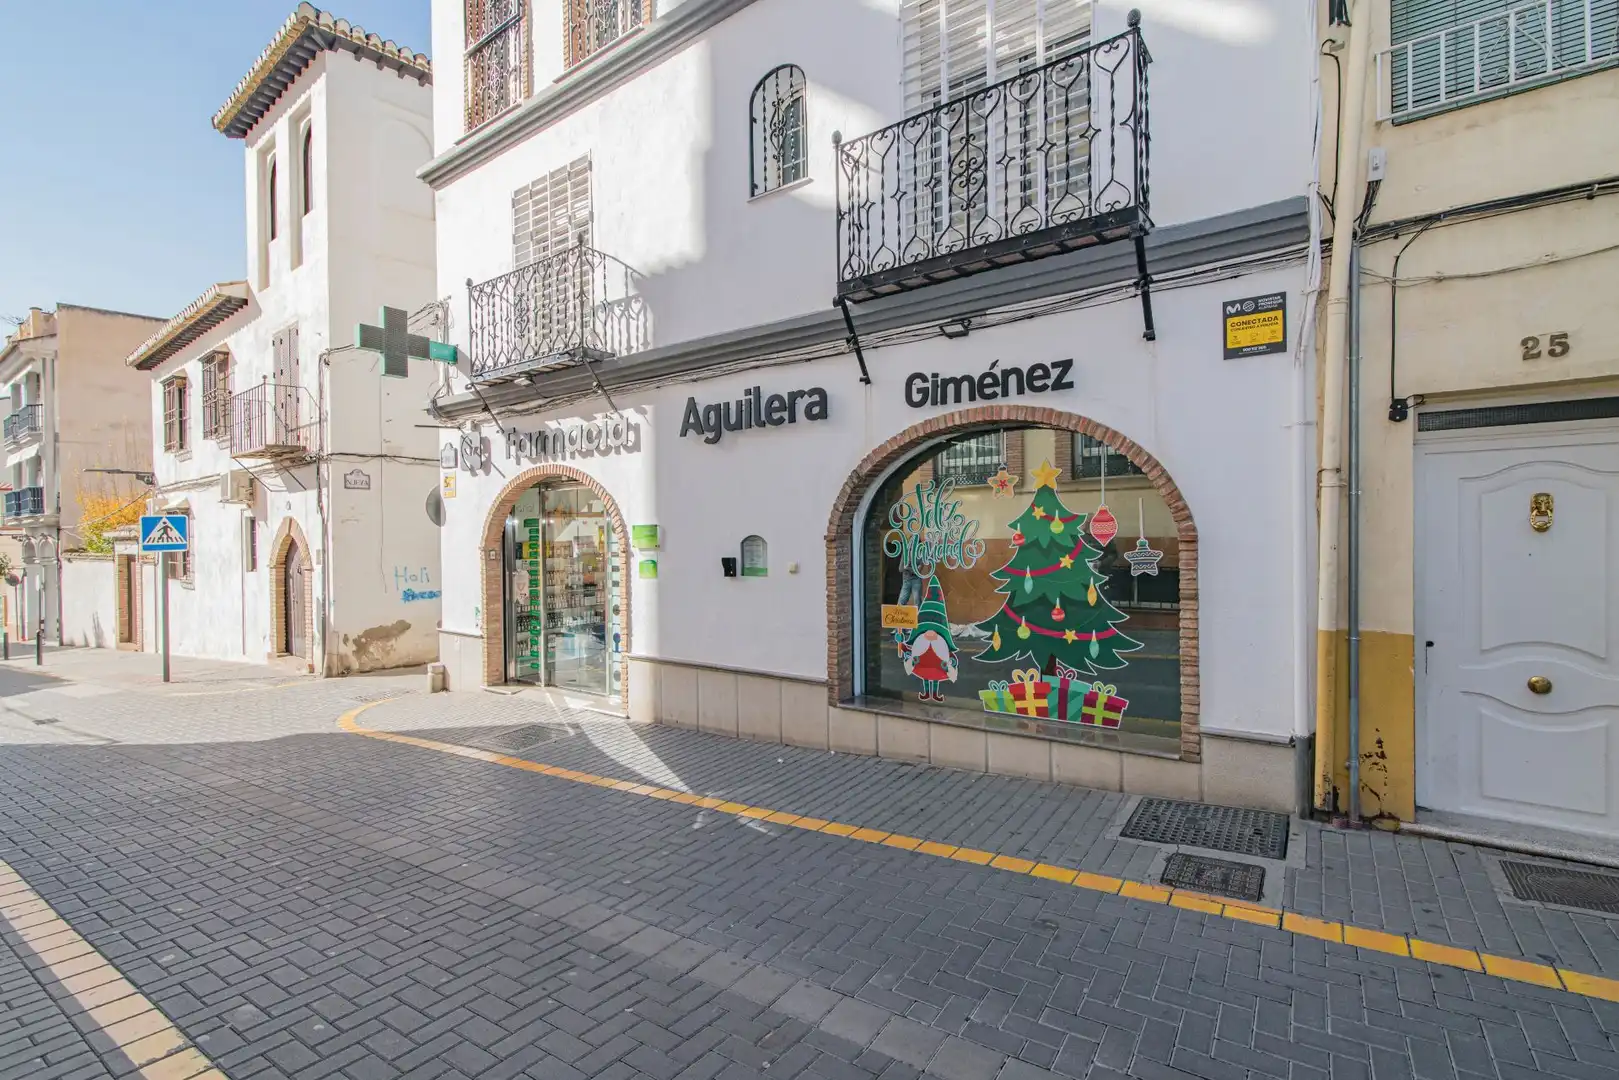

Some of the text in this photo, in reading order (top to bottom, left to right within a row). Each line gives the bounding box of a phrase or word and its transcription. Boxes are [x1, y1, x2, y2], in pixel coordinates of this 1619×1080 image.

[1230, 315, 1279, 328] CONECTADA
[1520, 332, 1570, 361] 25
[505, 358, 1075, 460] Farmacia Aguilera Giménez
[888, 477, 966, 534] Feliz
[884, 519, 986, 579] Navidad
